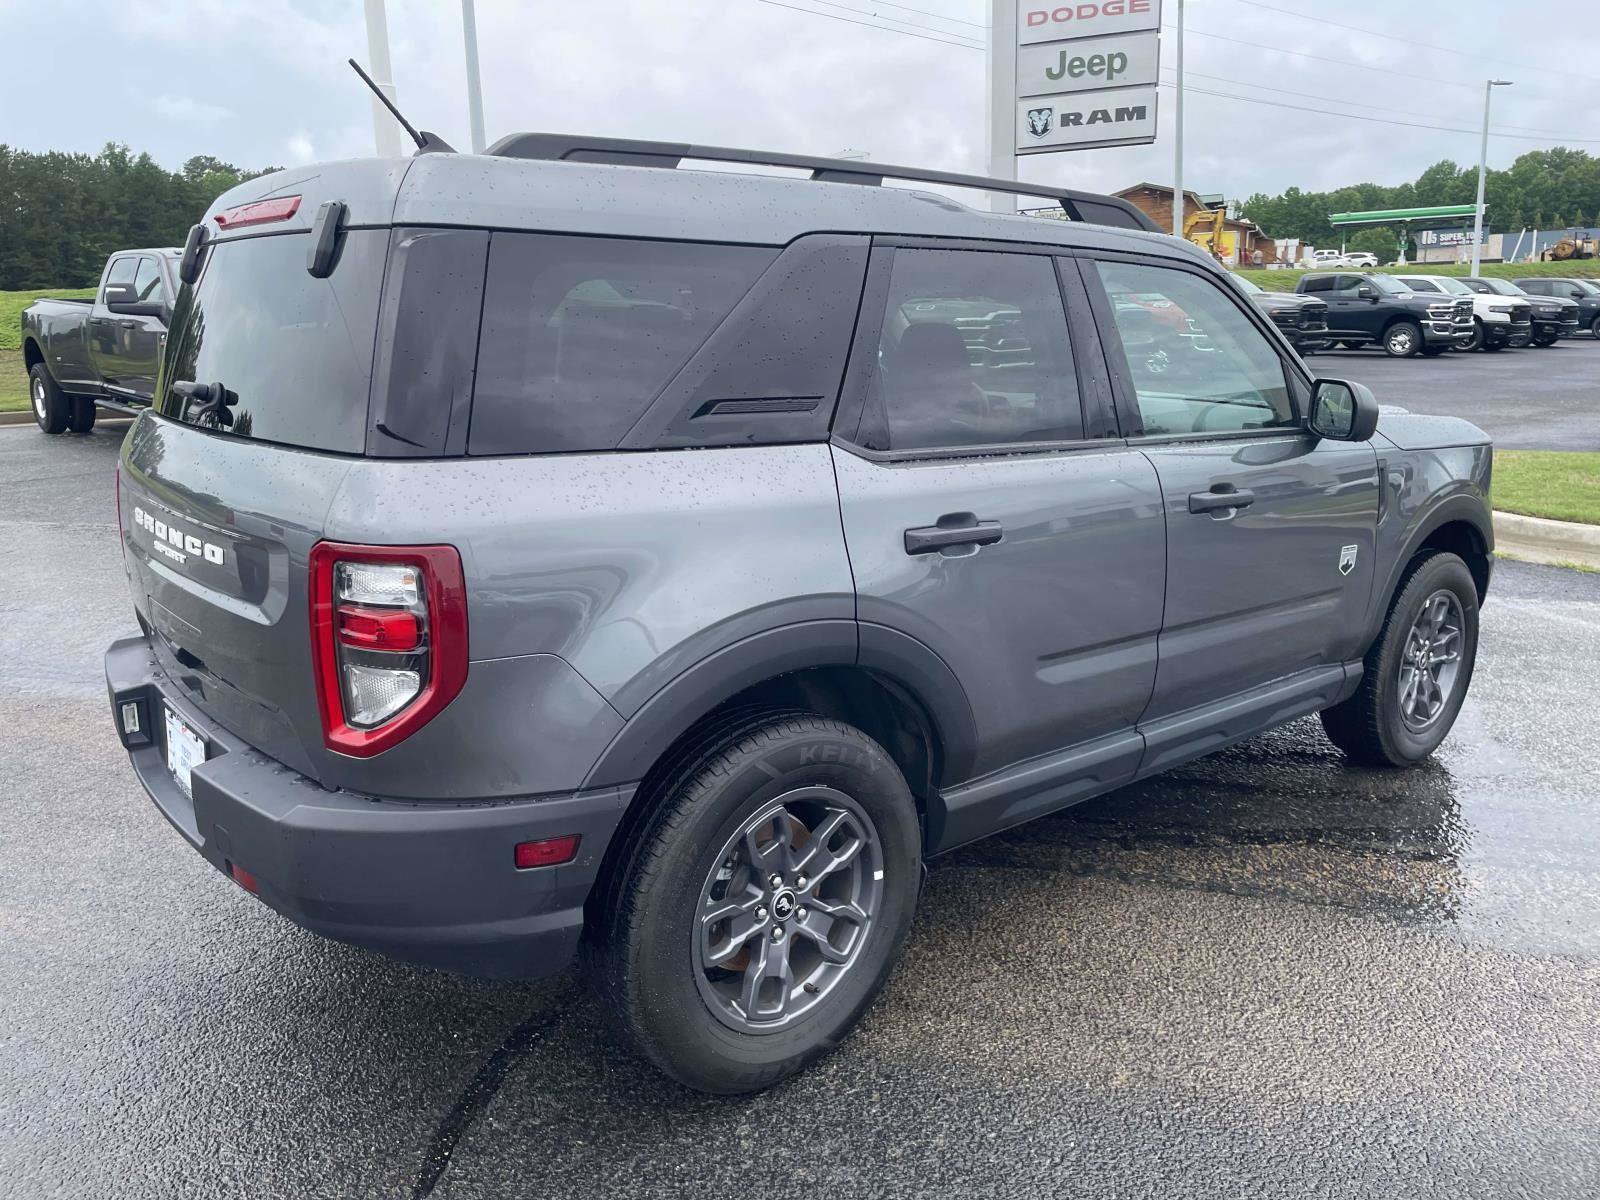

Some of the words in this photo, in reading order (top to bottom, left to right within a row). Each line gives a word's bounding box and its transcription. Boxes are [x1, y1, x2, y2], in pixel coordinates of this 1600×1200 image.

[1027, 0, 1151, 27] DODGE
[1045, 50, 1128, 81] Jeep
[1060, 105, 1147, 128] RAM
[134, 506, 225, 565] BRONCO
[153, 540, 188, 564] SPORT
